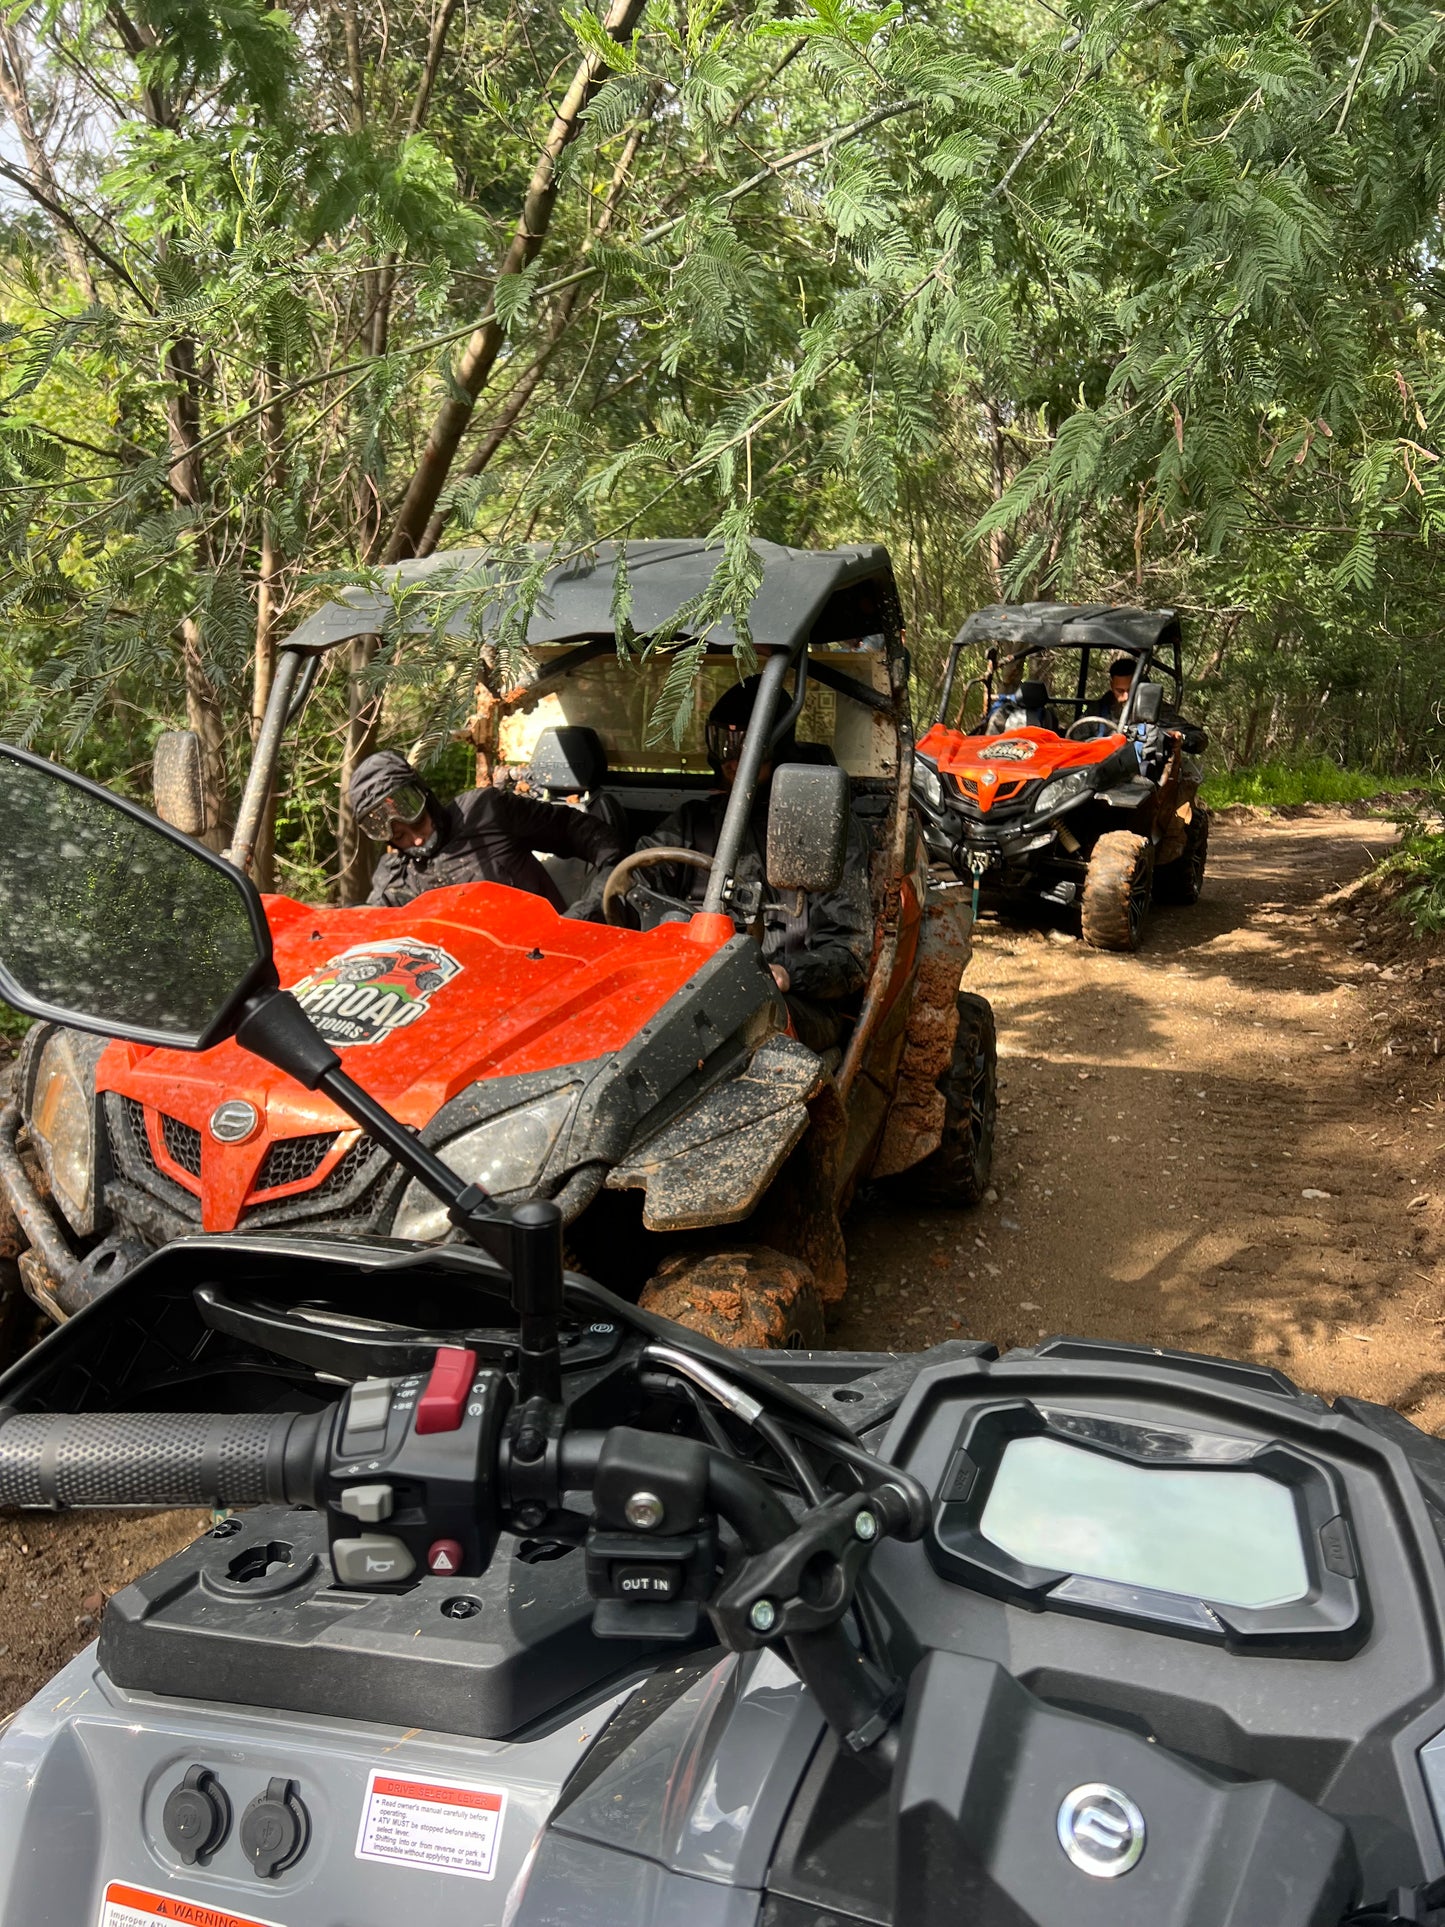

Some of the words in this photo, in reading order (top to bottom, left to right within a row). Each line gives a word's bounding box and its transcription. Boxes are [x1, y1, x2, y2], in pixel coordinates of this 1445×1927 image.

[297, 982, 424, 1028] FROAD
[317, 1014, 364, 1039] TOURS
[622, 1578, 649, 1591] OUT
[653, 1580, 670, 1591] IN
[387, 1783, 415, 1795] DRIVE
[418, 1788, 454, 1801] SELECT
[457, 1793, 488, 1806] LEVER
[379, 1809, 407, 1819] operating.
[381, 1799, 396, 1807] Read
[397, 1803, 419, 1811] owner's
[421, 1806, 442, 1815] manual
[443, 1810, 468, 1820] carefully
[469, 1813, 488, 1822] before
[376, 1826, 393, 1834] select
[395, 1828, 410, 1837] lever.
[378, 1817, 391, 1825] ATV
[392, 1819, 410, 1828] MUST
[420, 1824, 444, 1834] stopped
[444, 1827, 464, 1836] before
[464, 1830, 486, 1842] shifting
[374, 1834, 397, 1845] Shifting
[398, 1837, 410, 1845] into
[419, 1841, 433, 1849] from
[434, 1845, 456, 1854] reverse
[465, 1849, 478, 1857] park
[403, 1848, 425, 1858] without
[425, 1851, 450, 1863] applying
[465, 1858, 482, 1867] brake
[110, 1909, 146, 1926] Improper
[174, 1903, 239, 1927] WARNING
